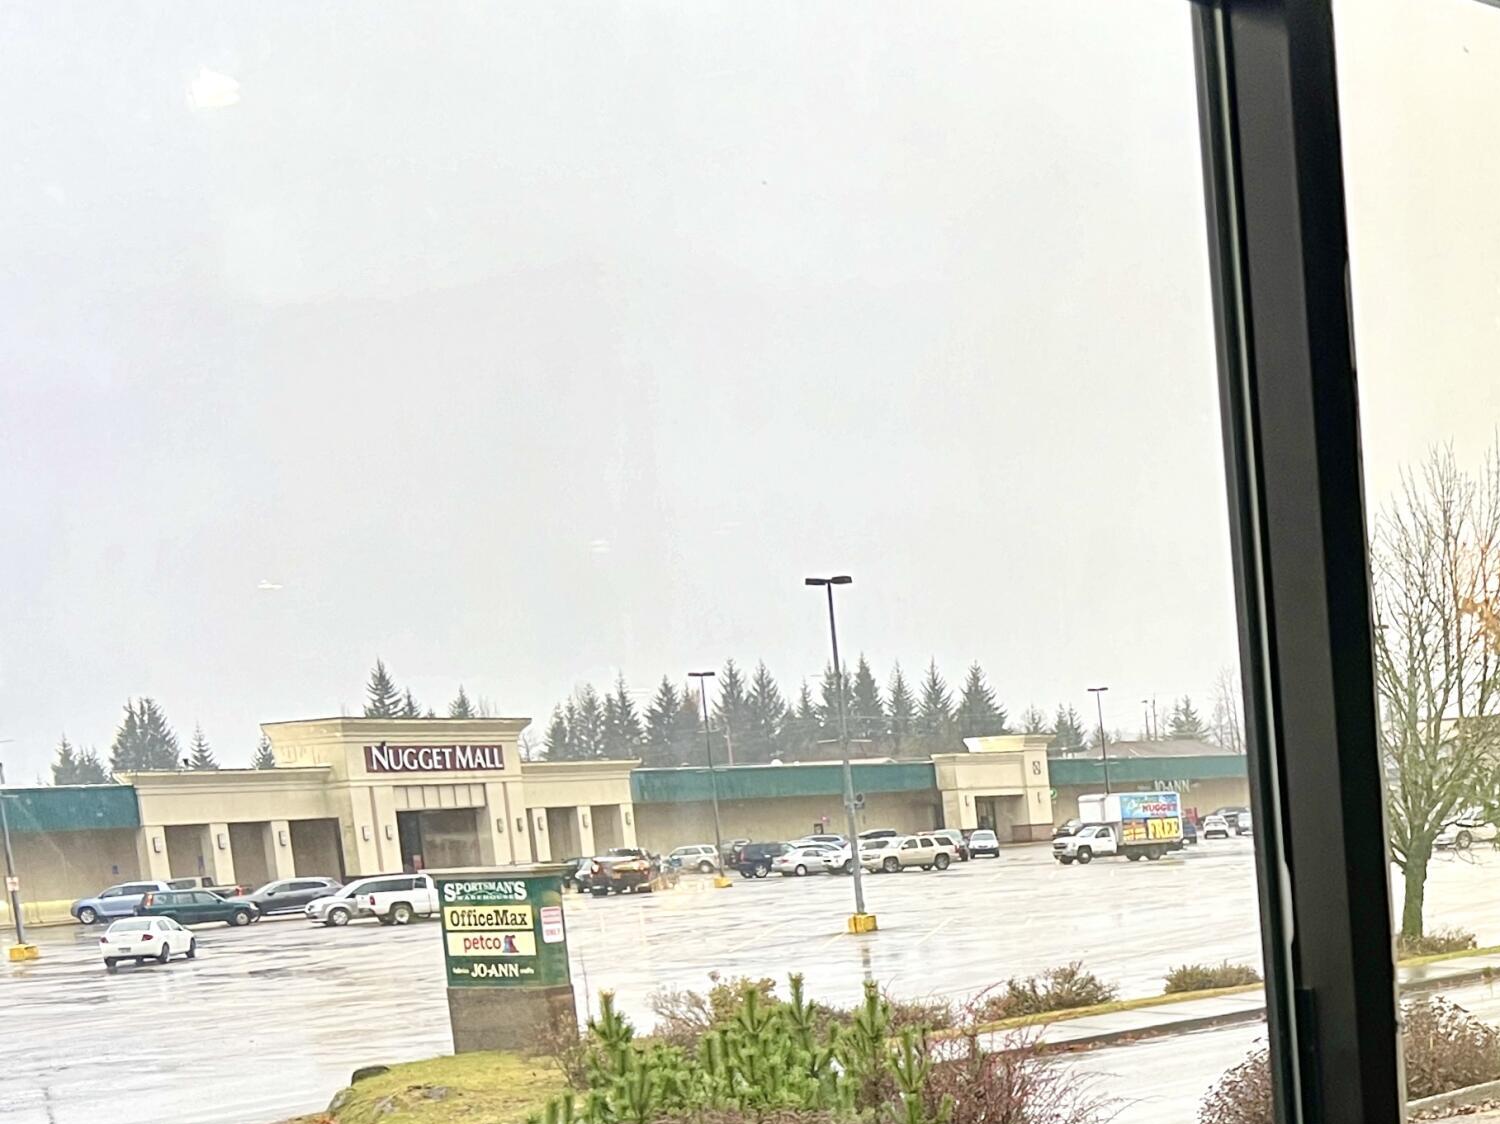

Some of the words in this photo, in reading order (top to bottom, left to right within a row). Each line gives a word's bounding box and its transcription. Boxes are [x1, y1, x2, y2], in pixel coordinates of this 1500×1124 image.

[371, 745, 452, 770] NUGGET
[455, 745, 504, 769] MALL
[444, 881, 527, 902] SPORTSMAN'S
[450, 909, 528, 927] OfficeMax
[463, 935, 502, 953] petco
